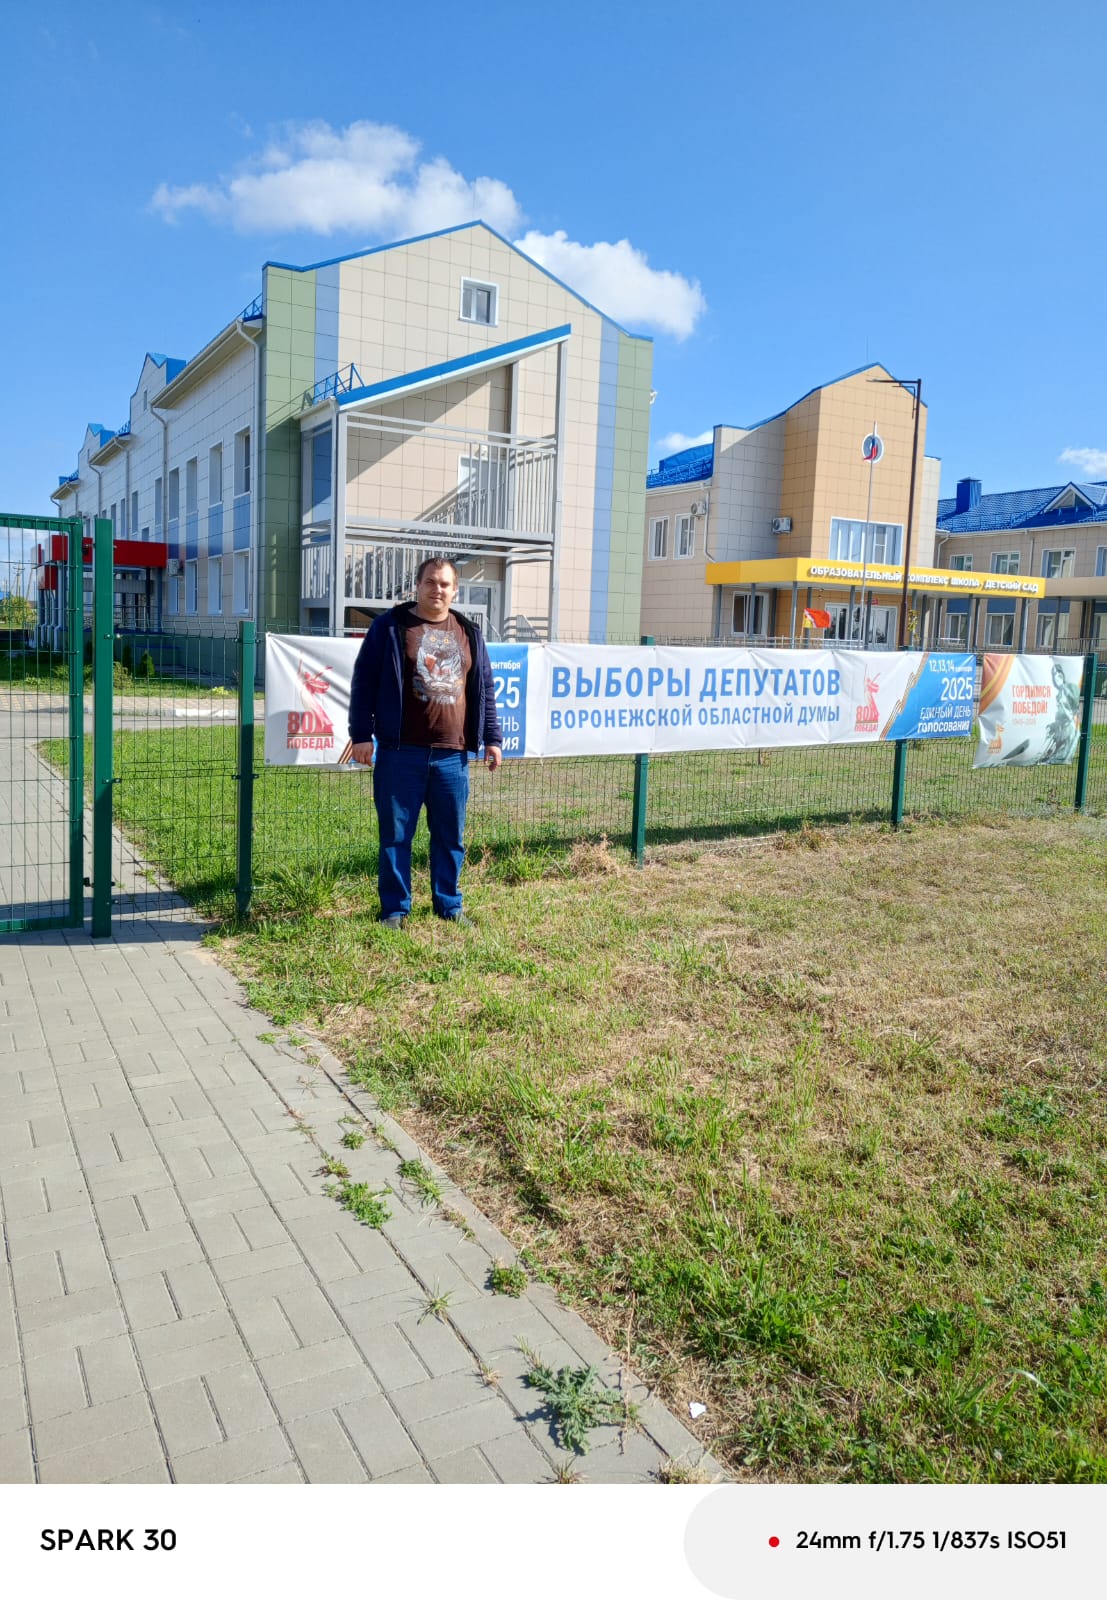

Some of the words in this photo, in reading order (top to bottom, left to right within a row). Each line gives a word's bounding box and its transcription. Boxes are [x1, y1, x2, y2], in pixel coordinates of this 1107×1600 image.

[810, 566, 902, 581] ОБРАЗОВАТЕЛЬНЫЙ
[908, 573, 949, 585] ОМПЛЕКС
[950, 577, 979, 587] ШКОЛА
[984, 579, 1020, 590] ДЕТСКИЙ
[1022, 583, 1039, 593] САД
[490, 661, 521, 671] ентября
[493, 676, 520, 709] 25
[551, 666, 691, 698] ВЫБОРЫ
[699, 668, 840, 702] ДЕПУТАТОВ
[941, 677, 973, 701] 2025
[1012, 685, 1051, 700] ГОРДИМСЯ
[550, 703, 692, 729] ВОРОНЕЖСКОЙ
[698, 702, 793, 725] ОБЛАСТНОЙ
[797, 705, 840, 726] ДУМЫ
[920, 704, 953, 720] ЕДИНЫЙ
[954, 705, 971, 719] ДЕНЬ
[1012, 700, 1048, 716] ПОБЕДОЙ!
[287, 737, 334, 750] ПОБЕДА!
